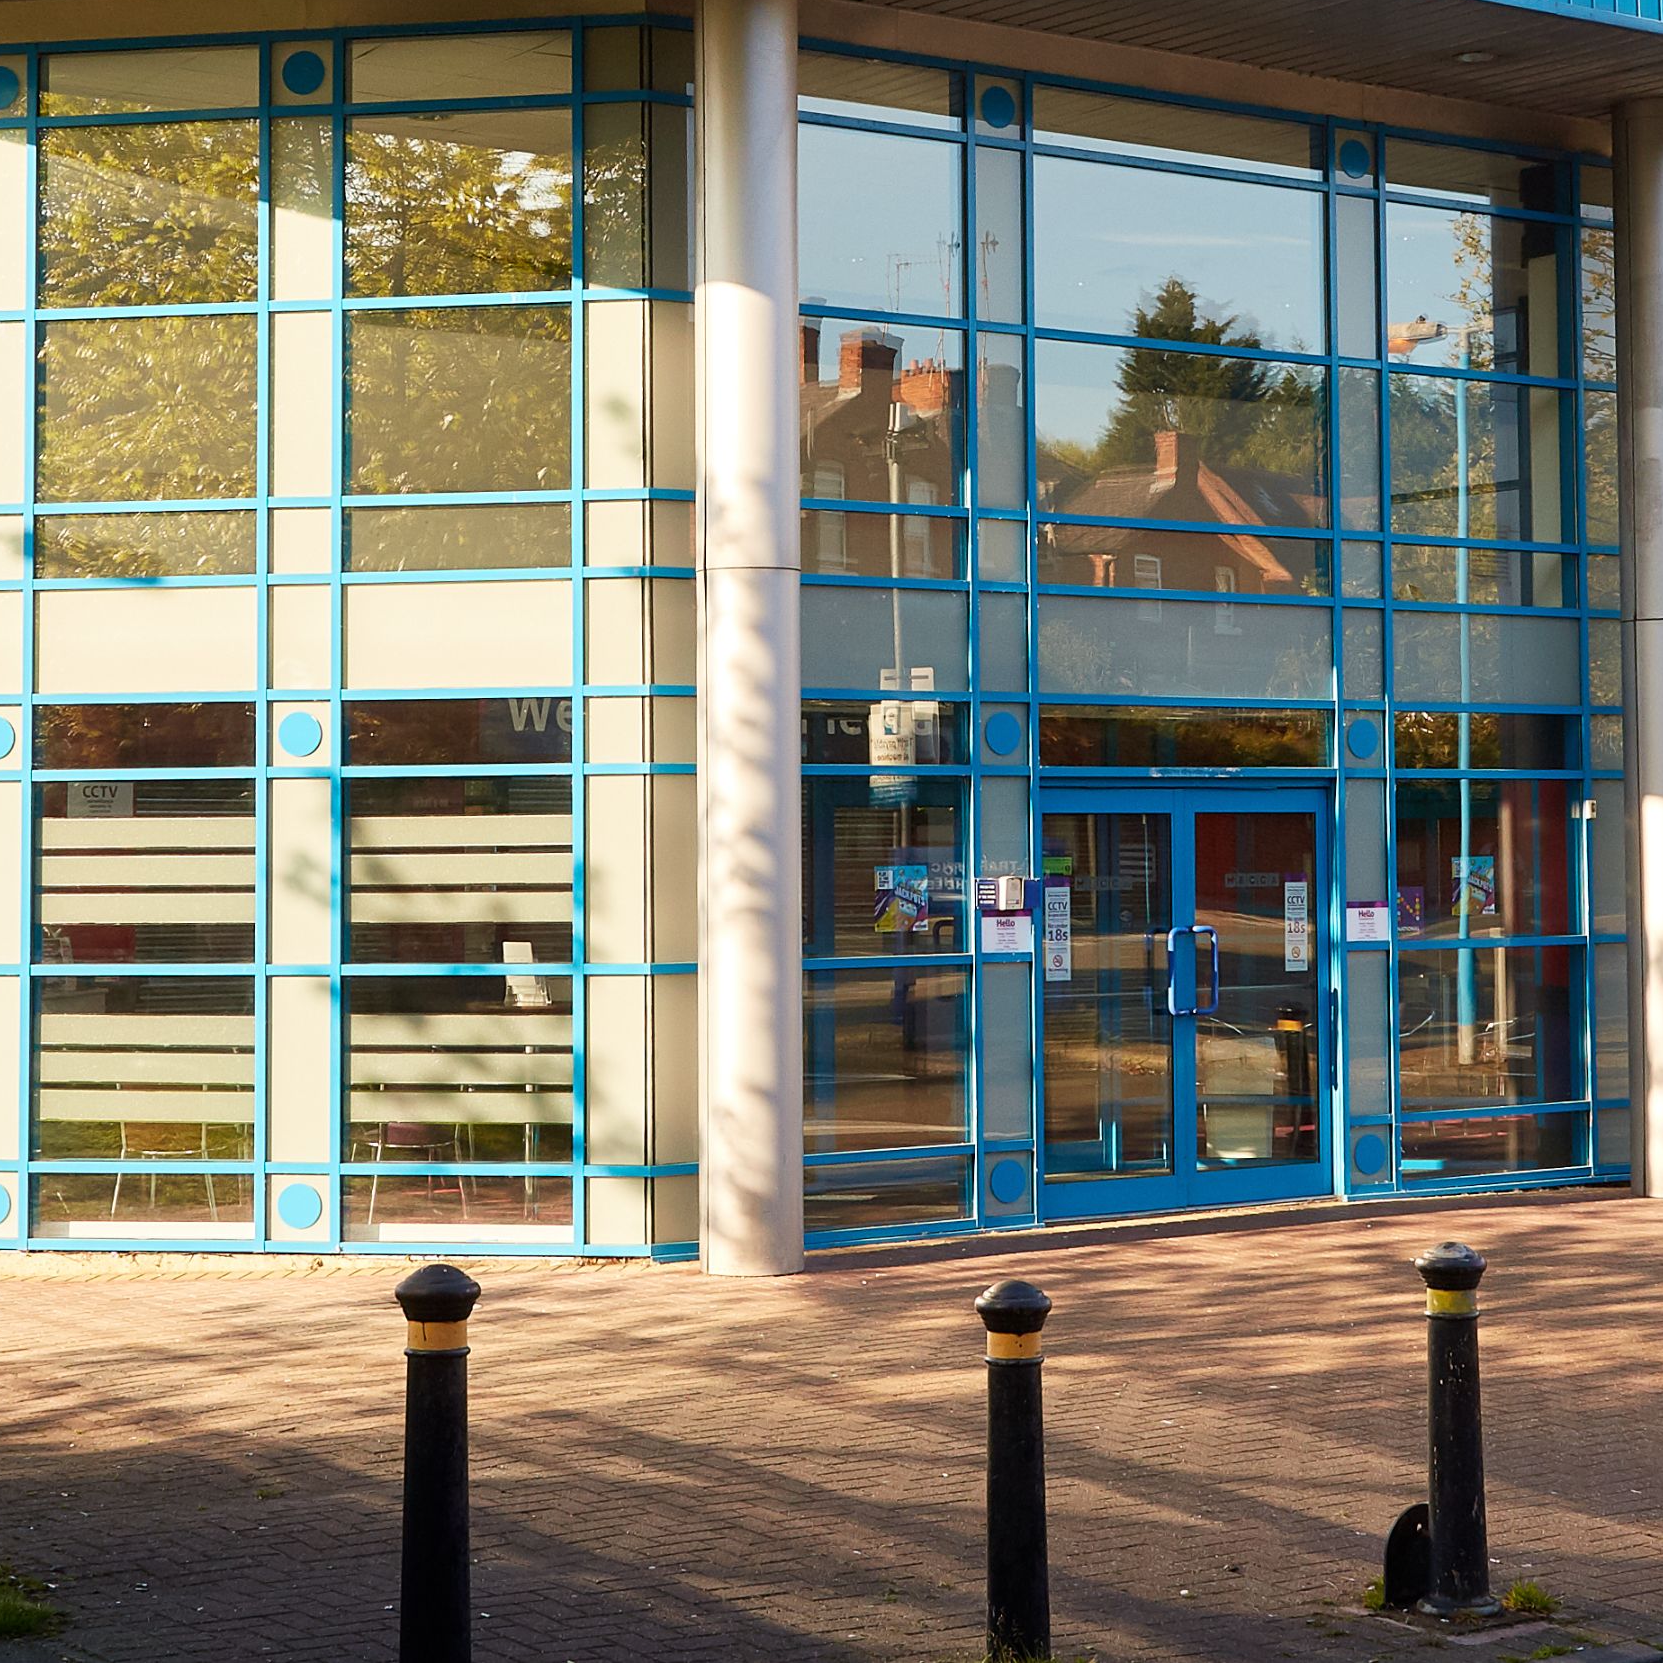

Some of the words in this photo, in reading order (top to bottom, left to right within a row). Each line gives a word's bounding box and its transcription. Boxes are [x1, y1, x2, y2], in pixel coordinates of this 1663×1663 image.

[83, 785, 118, 798] CCTV
[1287, 896, 1305, 904] CCTV
[1048, 901, 1068, 911] CCTV
[1358, 909, 1375, 918] Hello
[996, 919, 1016, 928] Hello
[1287, 922, 1306, 934] 18s
[1048, 929, 1068, 942] 18s
